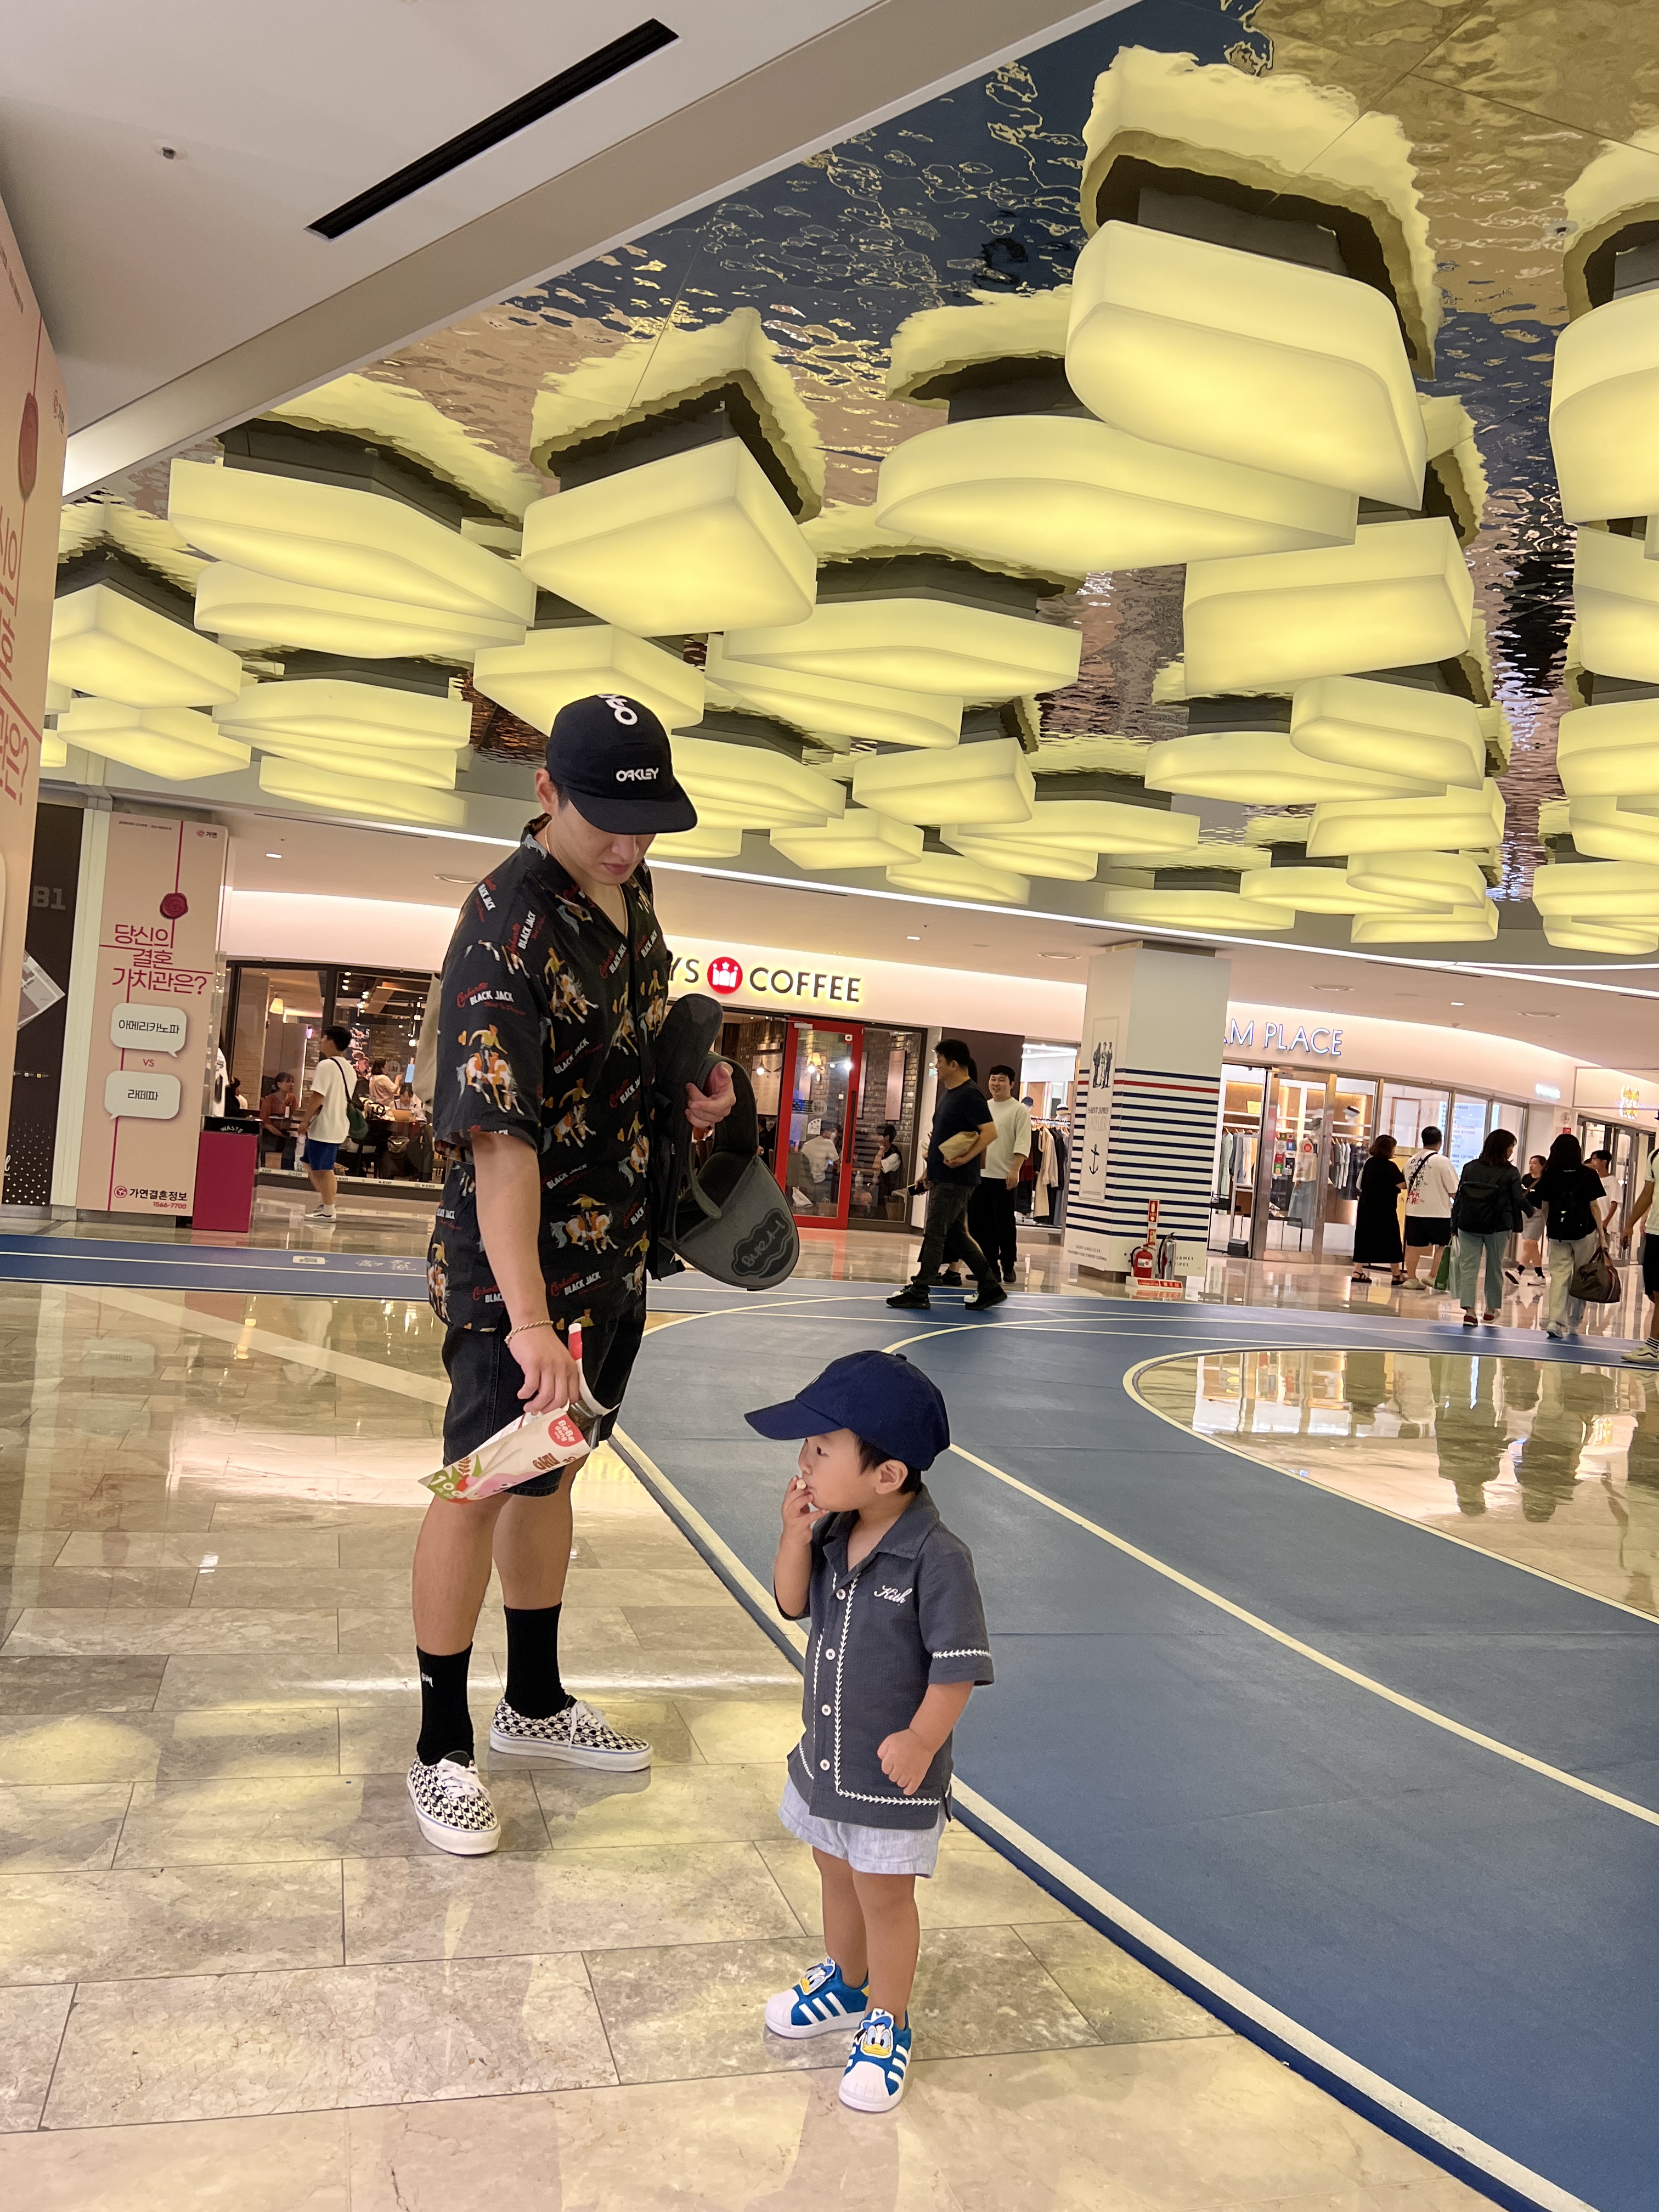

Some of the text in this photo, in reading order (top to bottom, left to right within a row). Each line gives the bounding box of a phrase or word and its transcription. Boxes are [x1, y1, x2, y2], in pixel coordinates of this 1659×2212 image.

[616, 768, 659, 782] OAKLEY
[32, 886, 66, 910] B1
[483, 896, 496, 911] JACK
[115, 924, 175, 949] 당신의
[517, 910, 536, 950] BLACK JACK
[640, 943, 653, 958] BLACK
[649, 929, 658, 945] JACK
[133, 949, 173, 969] 결혼
[608, 943, 628, 974] BLACK JACK
[112, 967, 207, 995] 가치관은?
[749, 967, 862, 1003] COFFEE
[469, 990, 494, 1006] BLACK
[494, 990, 515, 1003] JACK
[119, 1019, 180, 1034] 아메리카노파
[1223, 1018, 1343, 1056] M PLACE
[143, 1058, 155, 1067] VS
[554, 1054, 574, 1074] BLACK
[574, 1037, 590, 1056] JACK
[127, 1089, 159, 1101] 라떼파
[619, 1085, 636, 1104] BLACK
[220, 1125, 244, 1133] WASTE
[546, 1172, 568, 1189] BLACK
[129, 1188, 188, 1201] 가연결혼정보
[564, 1279, 585, 1295] BLACK
[586, 1271, 601, 1285] JACK
[485, 1293, 504, 1303] BLAC
